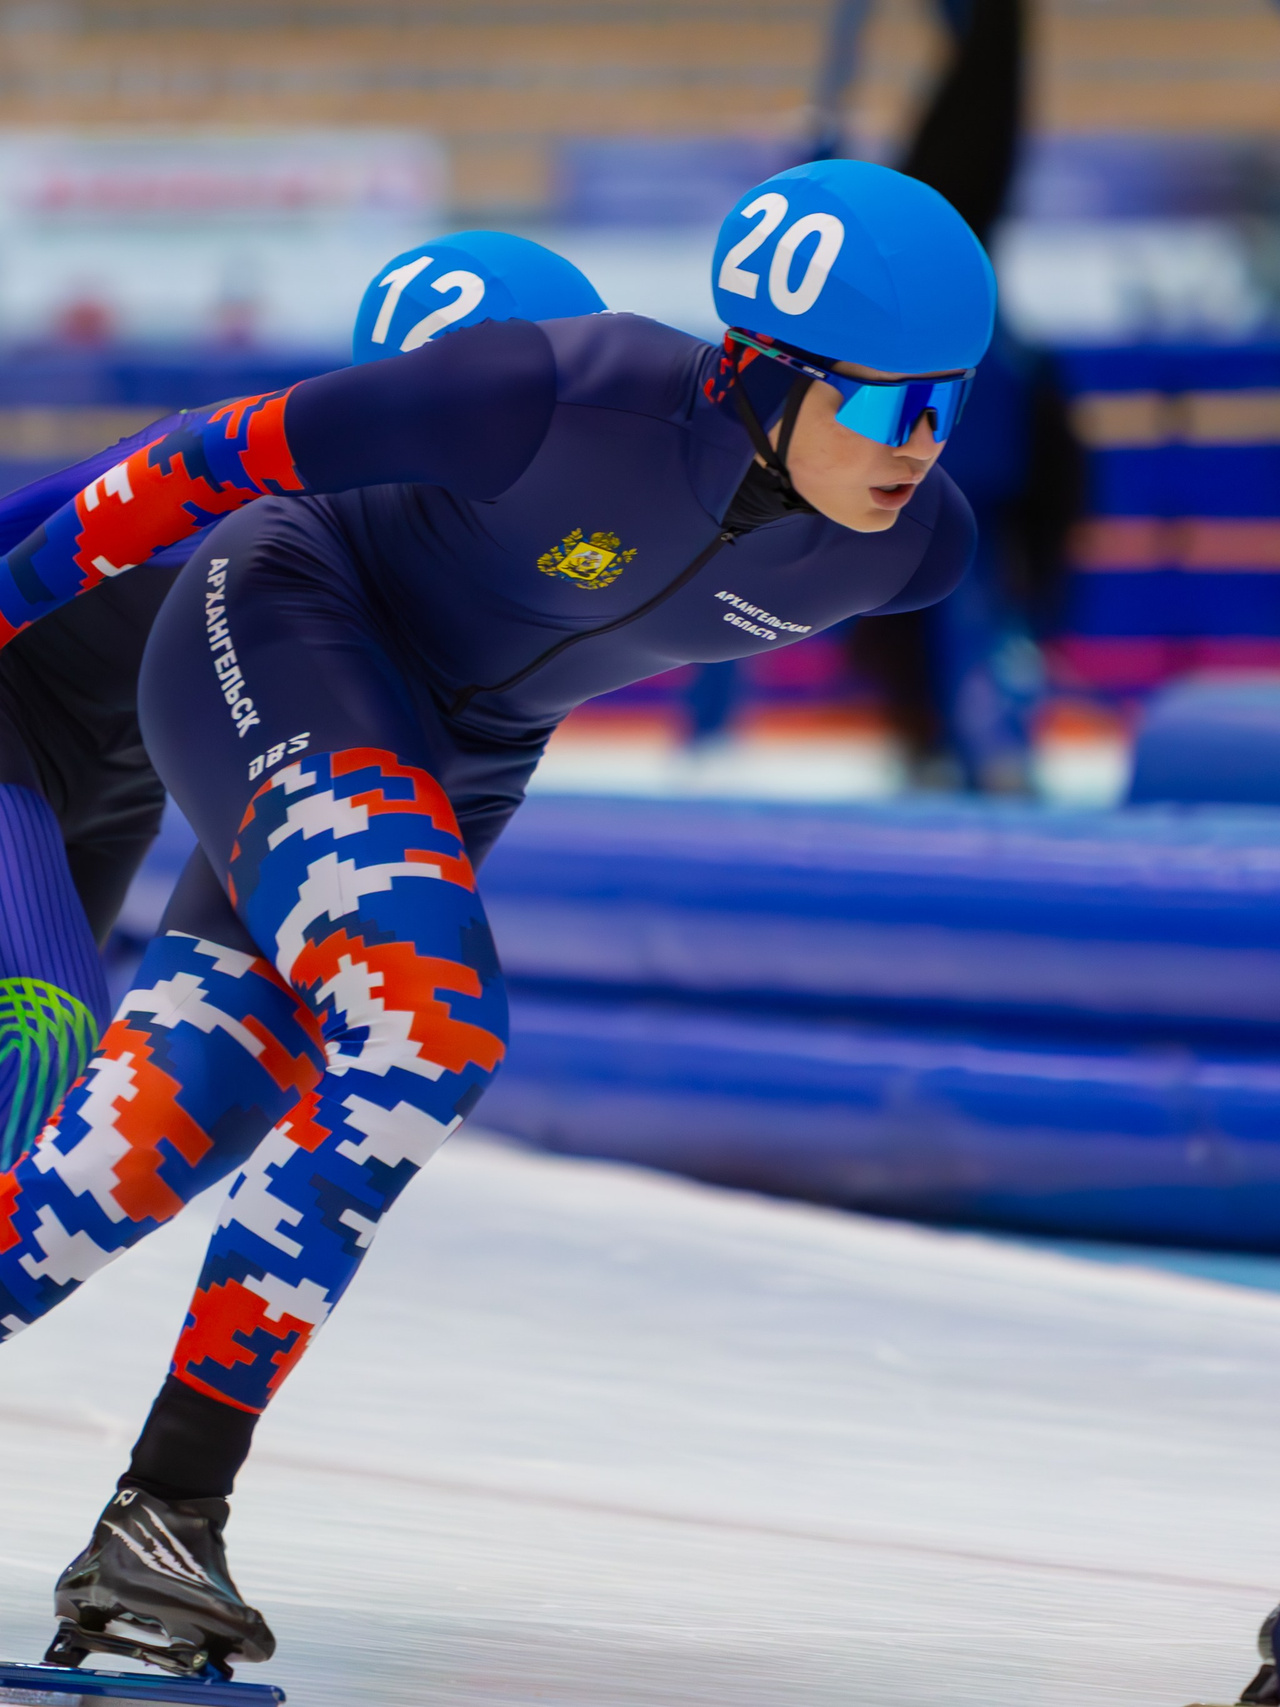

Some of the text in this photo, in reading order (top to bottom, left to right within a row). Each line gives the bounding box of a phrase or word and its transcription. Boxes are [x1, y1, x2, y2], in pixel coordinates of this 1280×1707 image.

[371, 256, 485, 353] 12
[718, 192, 845, 315] 20
[206, 558, 261, 738] АРХАНГЕЛЬСК
[723, 613, 777, 640] ОБЛАСТЬ
